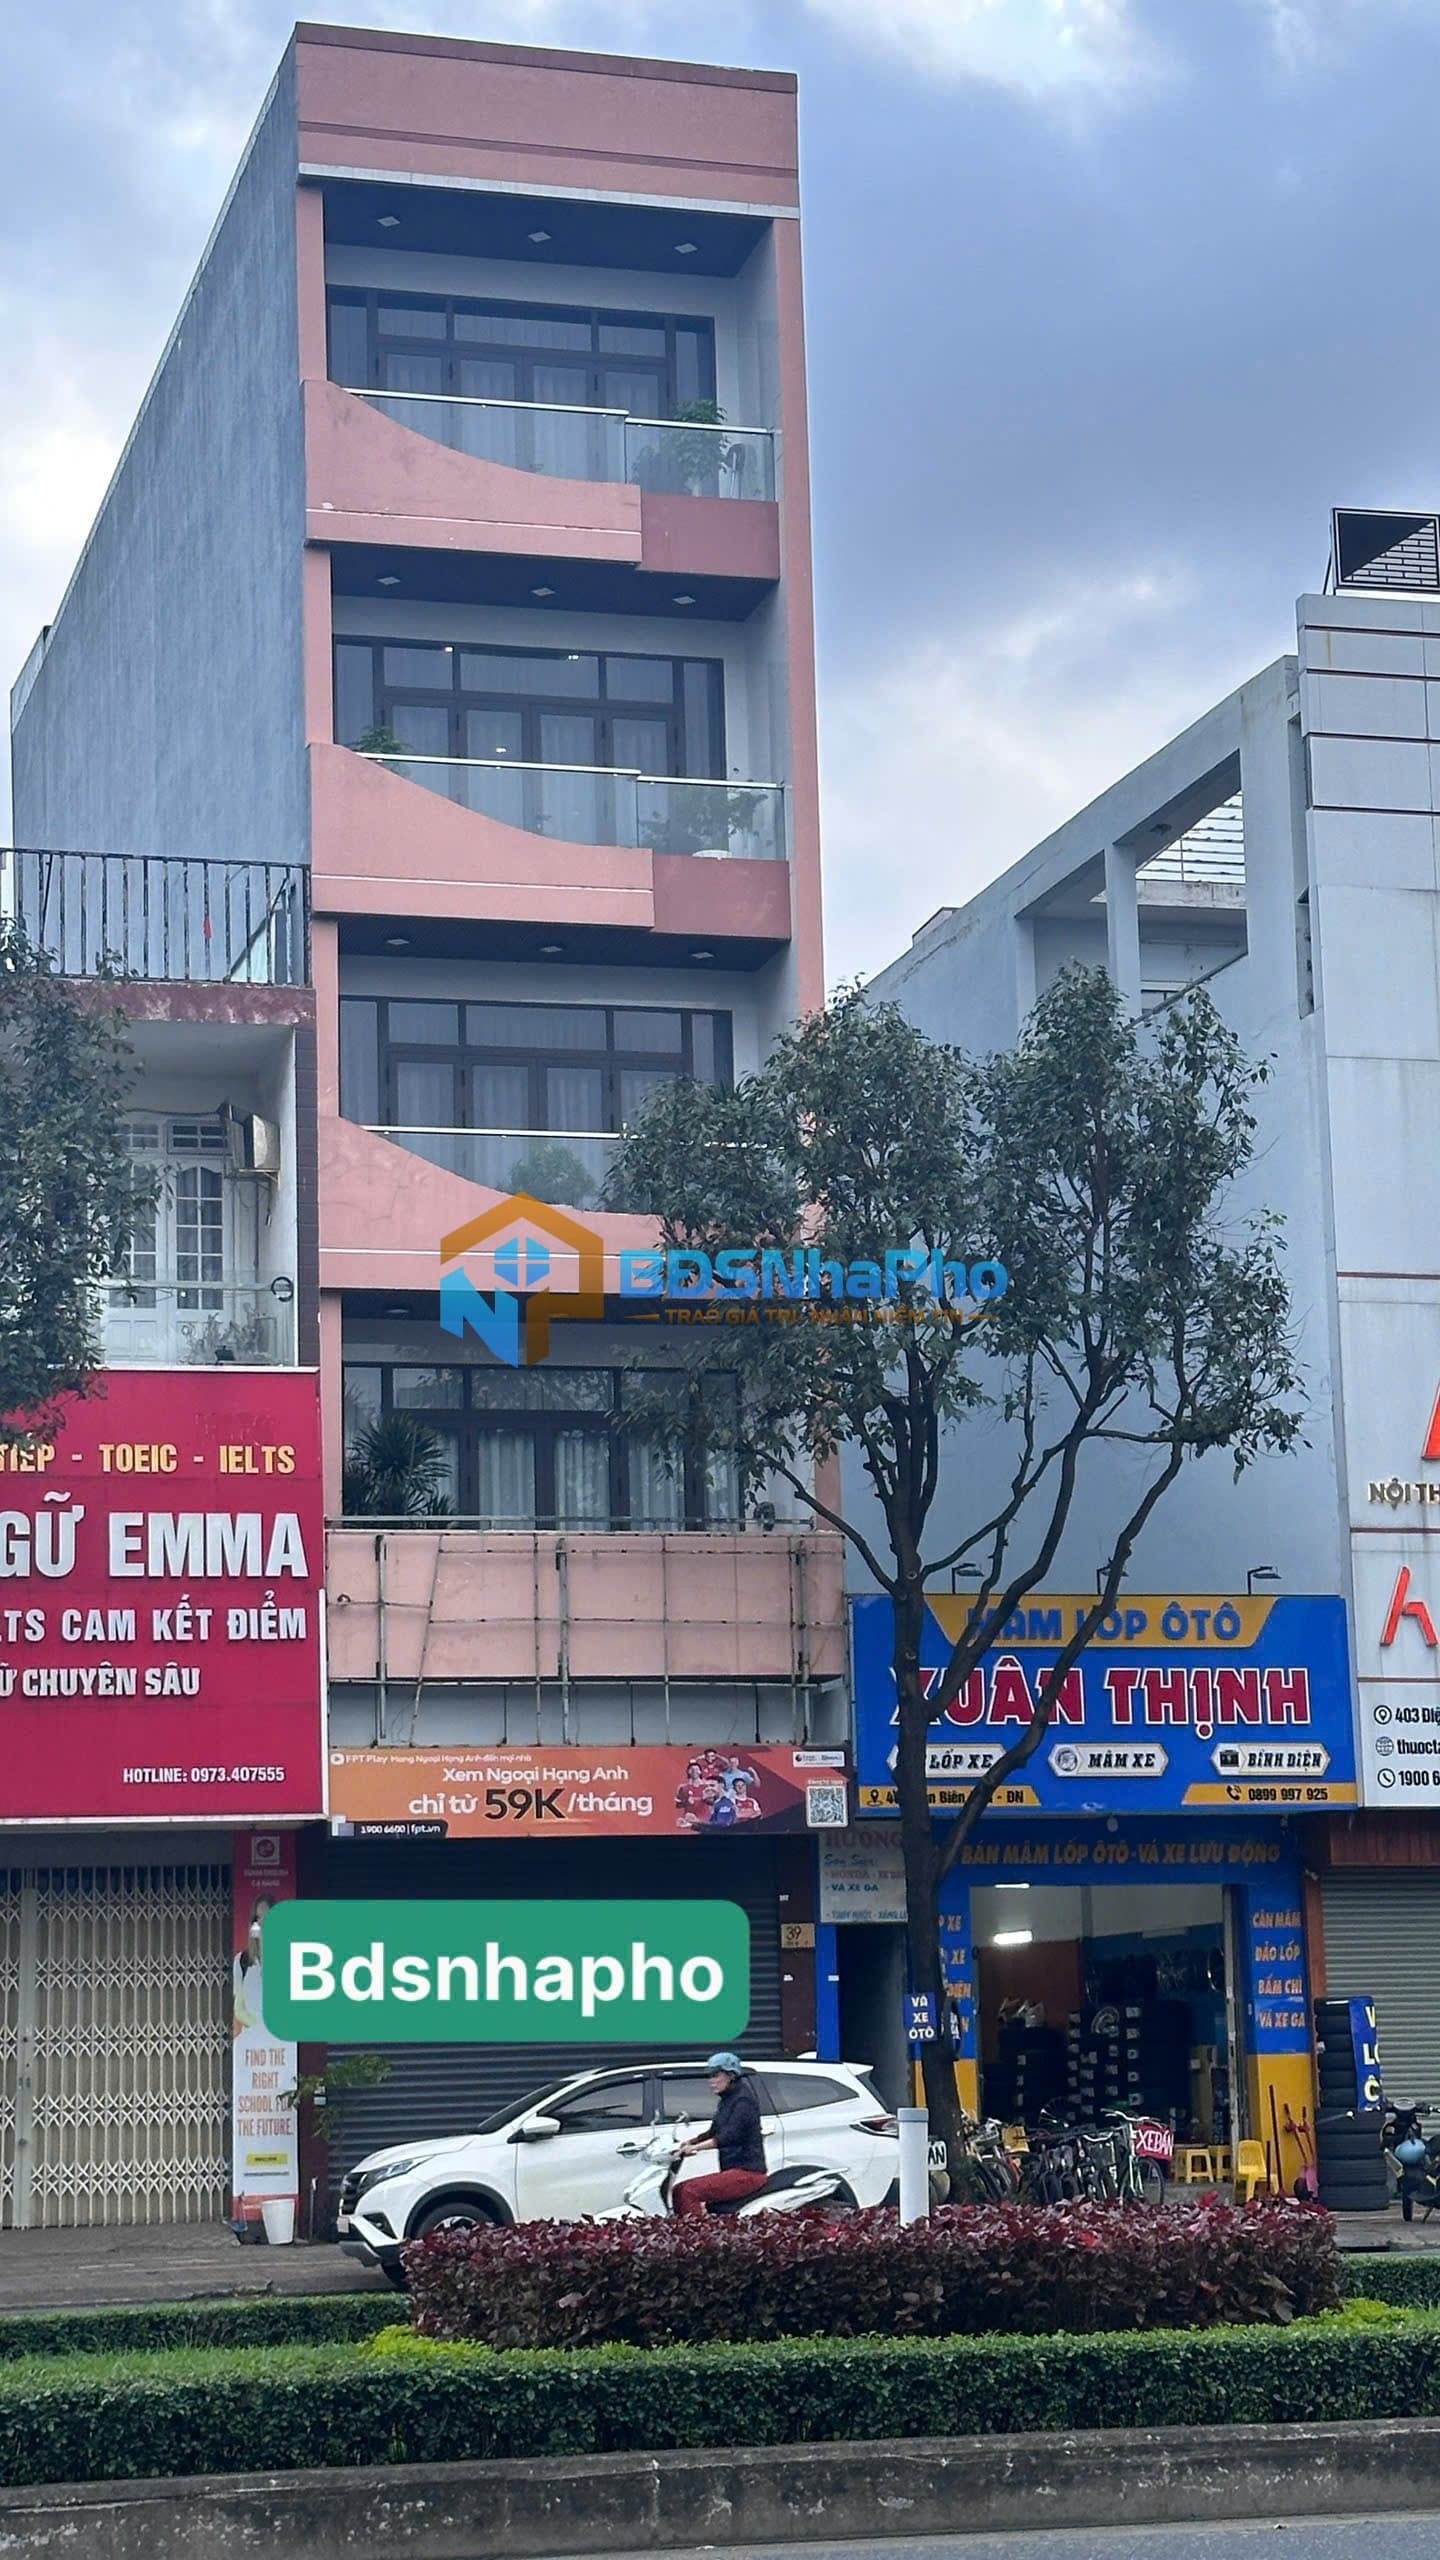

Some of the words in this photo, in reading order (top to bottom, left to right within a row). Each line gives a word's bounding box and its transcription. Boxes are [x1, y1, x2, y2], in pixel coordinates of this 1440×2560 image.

[99, 1443, 178, 1473] TOEIC
[219, 1443, 296, 1474] IELTS
[1368, 1477, 1411, 1510] NỘI
[108, 1511, 309, 1578] EMMA
[62, 1608, 137, 1642] CAM
[152, 1594, 213, 1641] KẾT
[227, 1590, 307, 1641] ĐIỂM
[1161, 1600, 1242, 1641] ÔTÔ
[22, 1660, 138, 1697] CHUYÊN
[144, 1661, 201, 1696] SÂU
[1103, 1667, 1311, 1740] THỊNH
[1395, 1707, 1420, 1724] 403
[929, 1749, 964, 1769] LỐP
[967, 1754, 994, 1769] XE
[1088, 1749, 1129, 1768] MÂM
[1132, 1753, 1156, 1768] XE
[123, 1767, 188, 1783] HOTLINE:
[191, 1766, 286, 1783] 0973.407555
[443, 1768, 483, 1783] Xem
[487, 1766, 539, 1786] Ngoại
[543, 1767, 590, 1785] Hạng
[593, 1766, 628, 1781] Anh
[1398, 1770, 1430, 1786] 1900
[1006, 1789, 1025, 1804] ĐN
[1248, 1787, 1278, 1801] 0899
[1280, 1787, 1302, 1801] 997
[1306, 1787, 1328, 1801] 925
[408, 1793, 444, 1815] chỉ
[449, 1794, 478, 1815] từ
[484, 1788, 566, 1820] 59K
[361, 1824, 383, 1834] 1900
[384, 1824, 406, 1834] 6600
[961, 1839, 1000, 1865] BÁN
[1002, 1839, 1050, 1865] MÂM
[1053, 1836, 1089, 1865] LỐP
[1162, 1842, 1185, 1865] XE
[786, 1926, 802, 1941] 39
[1279, 1940, 1301, 1961] LỐP
[912, 2011, 929, 2024] XE
[908, 2025, 935, 2040] ÔTÔ
[245, 2048, 267, 2066] FIND
[269, 2047, 286, 2066] THE
[252, 2071, 279, 2090] RIGHT
[238, 2095, 273, 2113] SCHOOL
[238, 2119, 255, 2137] THE
